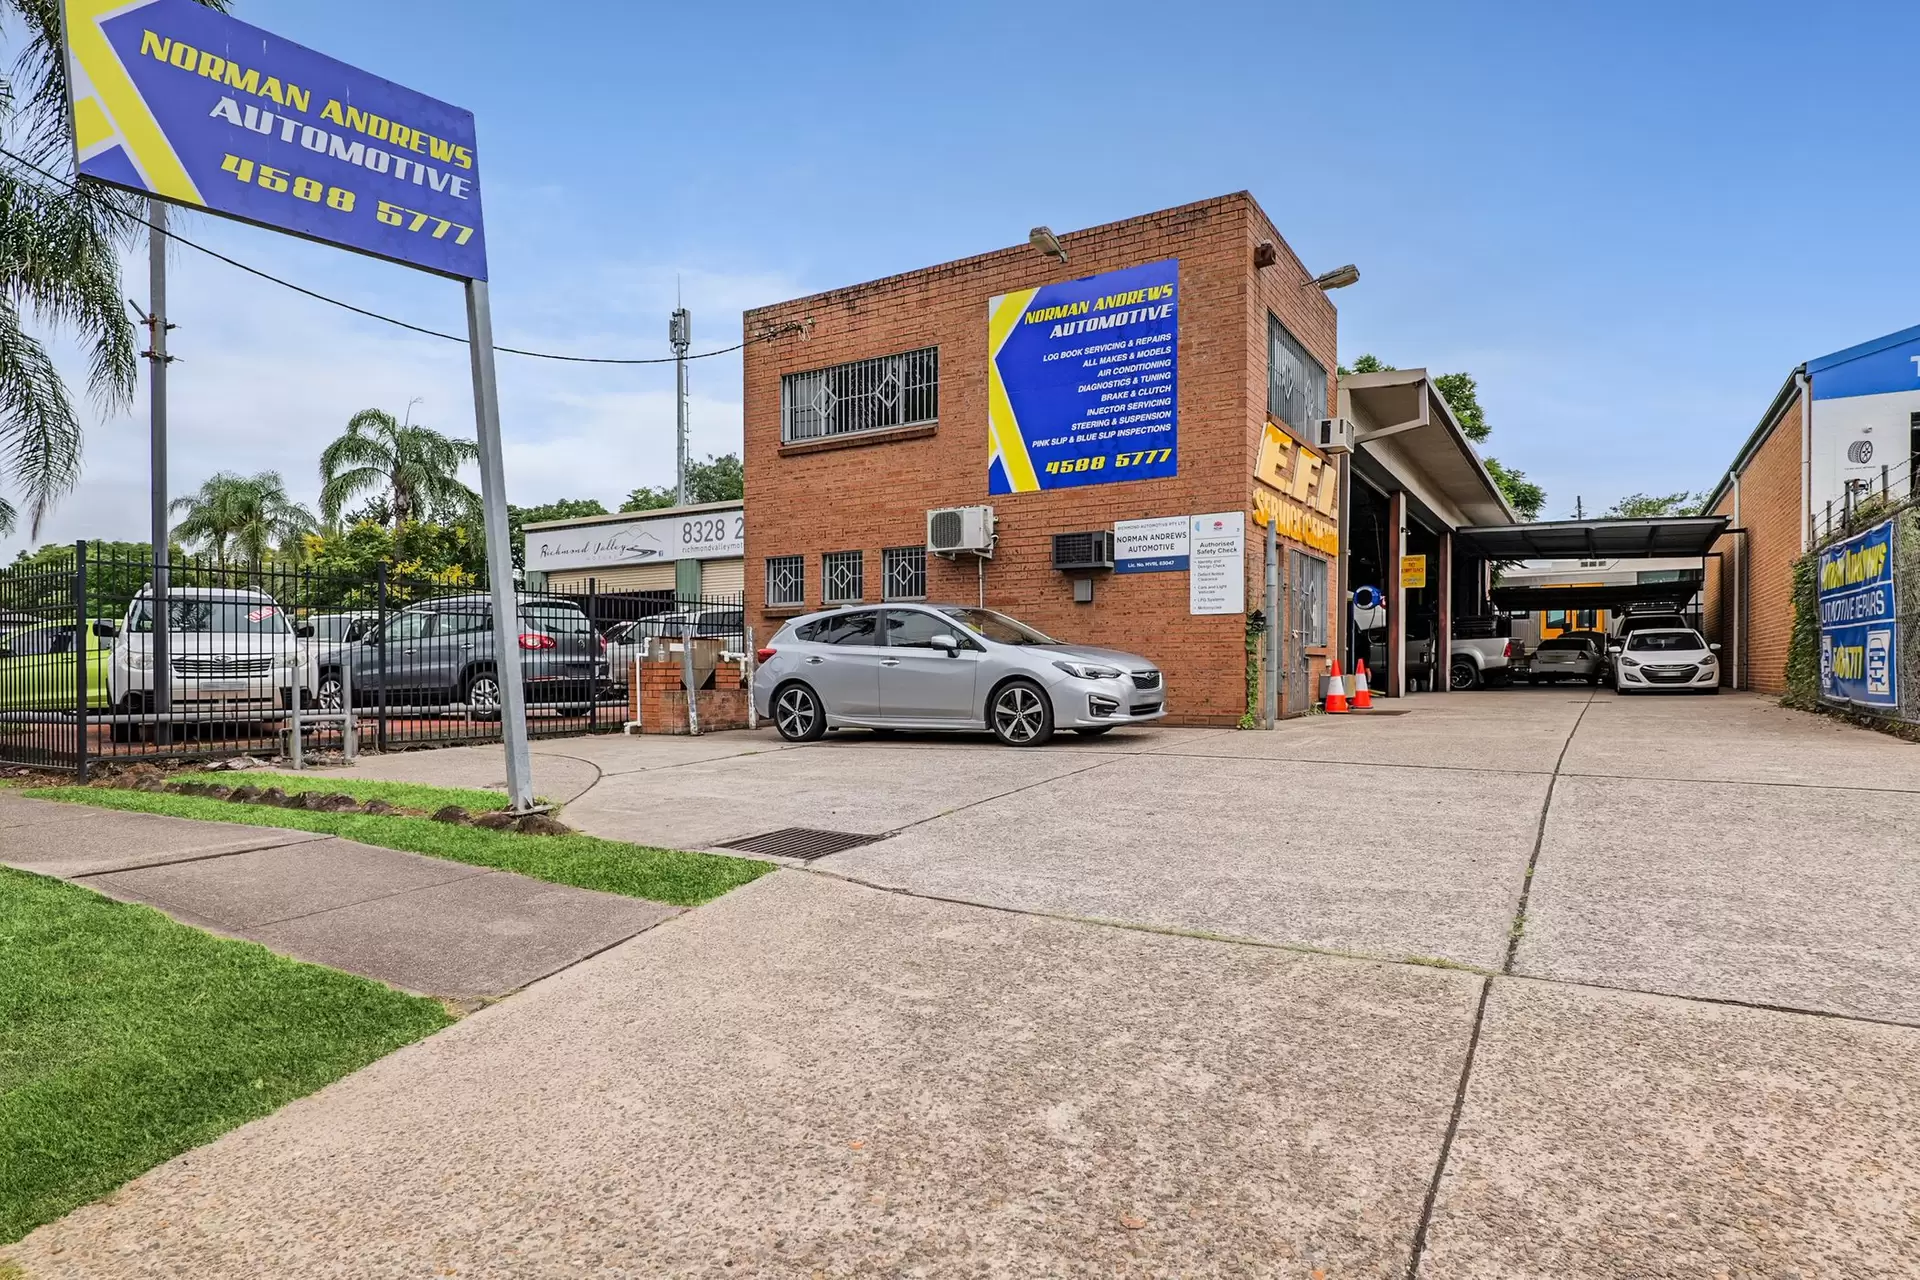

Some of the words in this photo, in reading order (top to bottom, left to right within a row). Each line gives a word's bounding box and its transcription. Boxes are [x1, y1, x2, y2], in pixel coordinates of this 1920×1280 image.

[140, 28, 311, 112] NORMAN
[319, 98, 473, 170] ANDREWS
[209, 95, 472, 200] AUTOMOTIVE
[220, 152, 357, 214] 4588
[376, 200, 475, 246] 5777
[1024, 301, 1090, 325] NORMAN
[1093, 283, 1174, 312] ANDREWS
[1049, 303, 1174, 339] AUTOMOTIVE
[1043, 354, 1060, 362] LOG
[1060, 348, 1083, 360] BOOK
[1084, 340, 1127, 355] SERVICING
[1128, 339, 1134, 347] &
[1135, 333, 1172, 346] REPAIRS
[1082, 358, 1098, 367] ALL
[1099, 353, 1128, 366] MAKES
[1129, 352, 1135, 360] &
[1136, 346, 1172, 359] MODELS
[1097, 368, 1112, 378] AIR
[1112, 359, 1171, 376] CONDITIONING
[1078, 377, 1132, 394] DIAGNOSTICS
[1132, 376, 1139, 385] &
[1140, 372, 1171, 383] TUNING
[1101, 391, 1129, 402] BRAKE
[1130, 390, 1137, 398] &
[1137, 385, 1172, 397] CLUTCH
[1087, 404, 1126, 417] INJECTOR
[1127, 397, 1171, 411] SERVICING
[1071, 419, 1110, 431] STEERING
[1111, 417, 1118, 426] &
[1119, 410, 1172, 425] SUSPENSION
[1032, 439, 1050, 448] PINK
[1050, 436, 1068, 446] SLIP
[1069, 436, 1075, 444] &
[1076, 432, 1097, 442] BLUE
[1098, 430, 1116, 440] SLIP
[1117, 423, 1172, 438] INSPECTIONS
[1045, 455, 1106, 475] 4588
[1115, 448, 1173, 466] 5777
[683, 519, 725, 544] 8328
[1116, 534, 1148, 543] NORMAN
[1150, 531, 1187, 541] ANDREWS
[540, 541, 590, 558] Richmond
[594, 539, 627, 556] Valley
[1128, 543, 1175, 553] AUTOMOTIVE
[1200, 540, 1235, 548] Authorised
